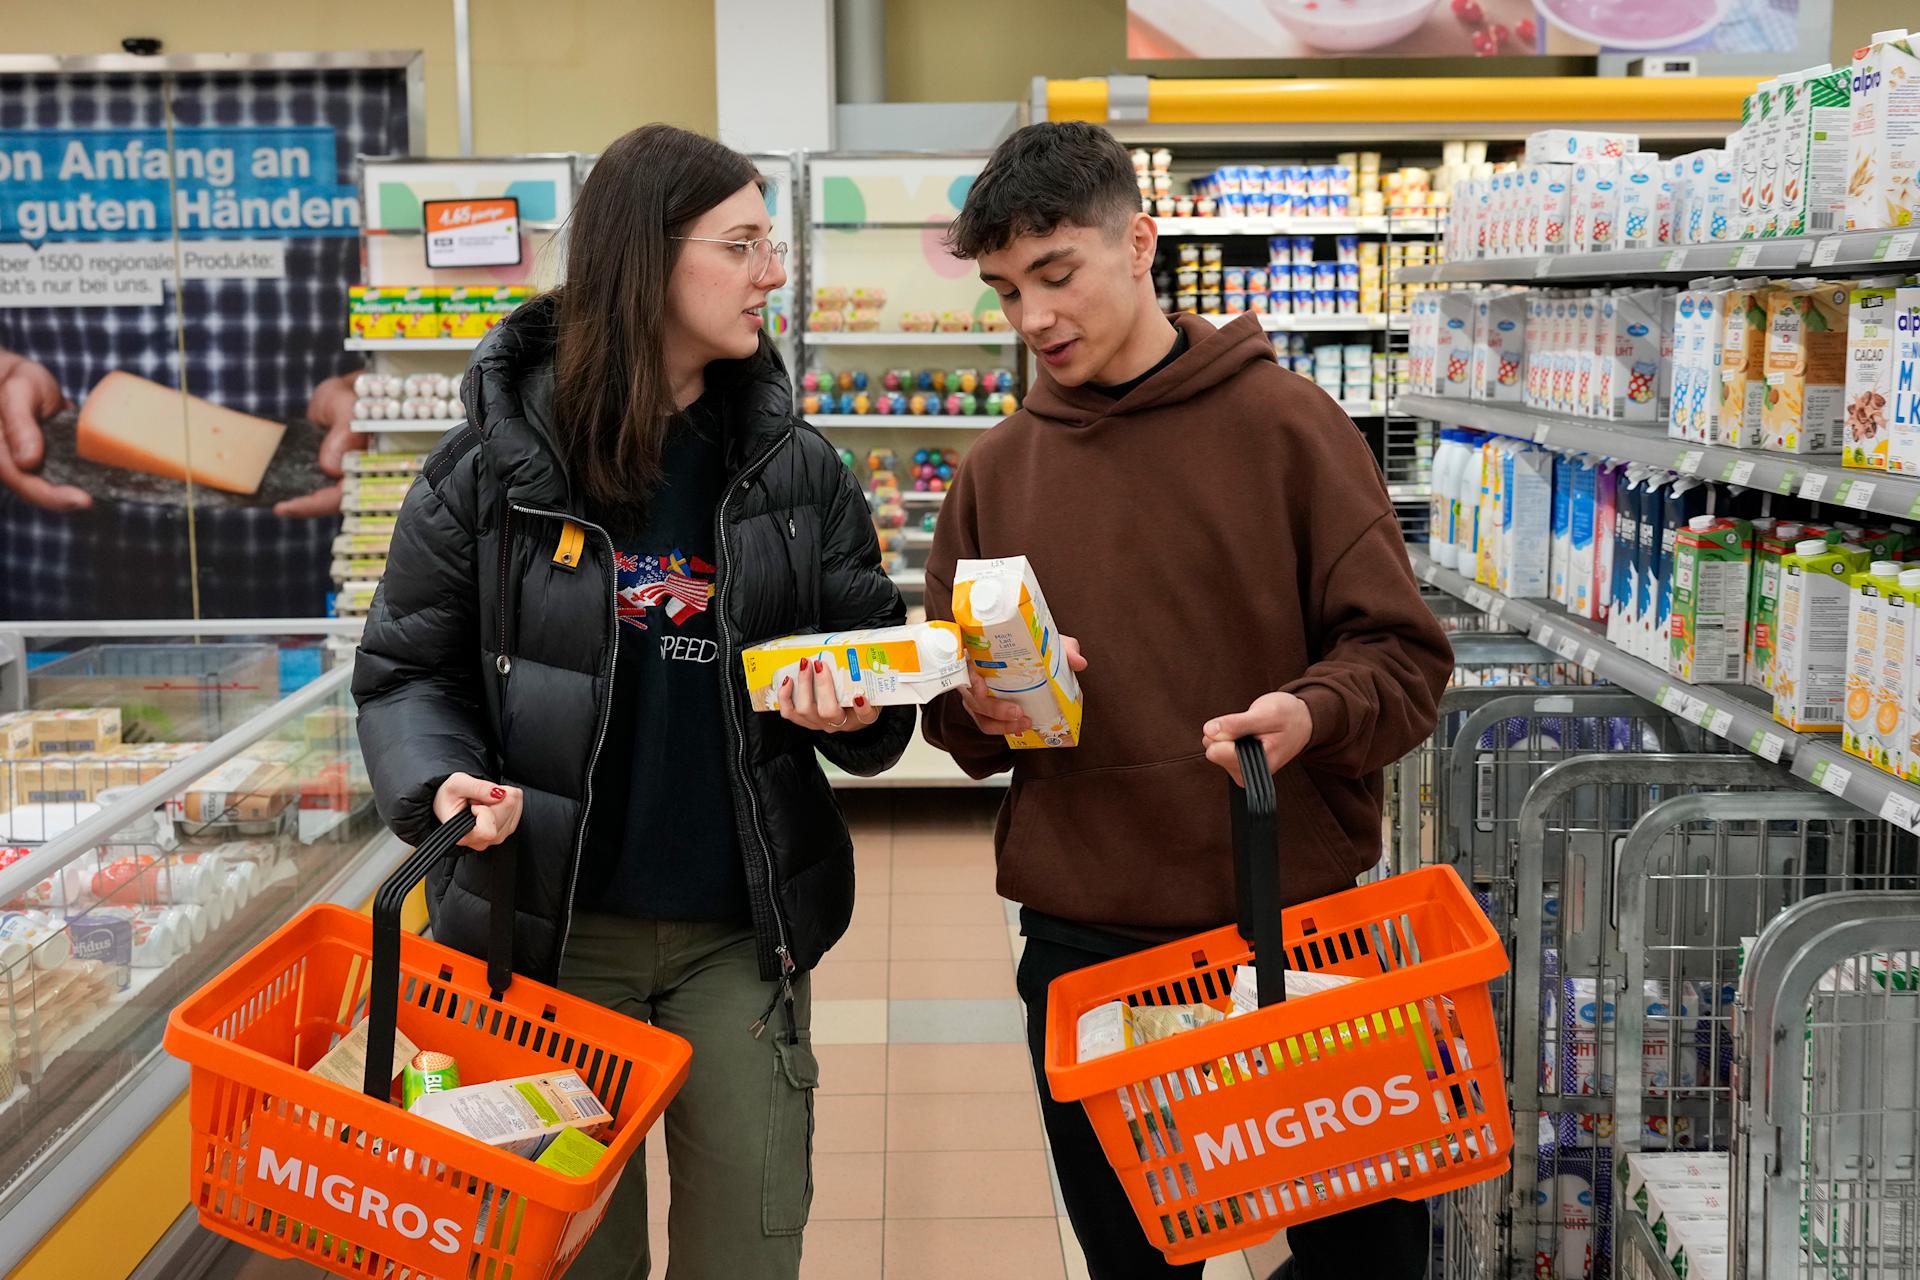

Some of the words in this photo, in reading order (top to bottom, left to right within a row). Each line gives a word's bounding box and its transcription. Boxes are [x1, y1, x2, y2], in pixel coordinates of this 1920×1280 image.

[1853, 67, 1881, 96] alpro
[59, 140, 234, 185] Anfang
[252, 146, 310, 179] an
[17, 193, 156, 238] guten
[176, 186, 359, 229] Händen
[40, 253, 83, 271] 1500
[89, 252, 176, 275] regionale
[184, 251, 273, 270] Produkte:
[43, 280, 71, 294] nur
[80, 277, 108, 294] bei
[114, 278, 152, 294] uns.
[1854, 349, 1884, 361] CACAO
[1643, 1040, 1666, 1055] HT
[1193, 1074, 1421, 1171] MIGROS
[256, 1146, 463, 1254] MIGROS
